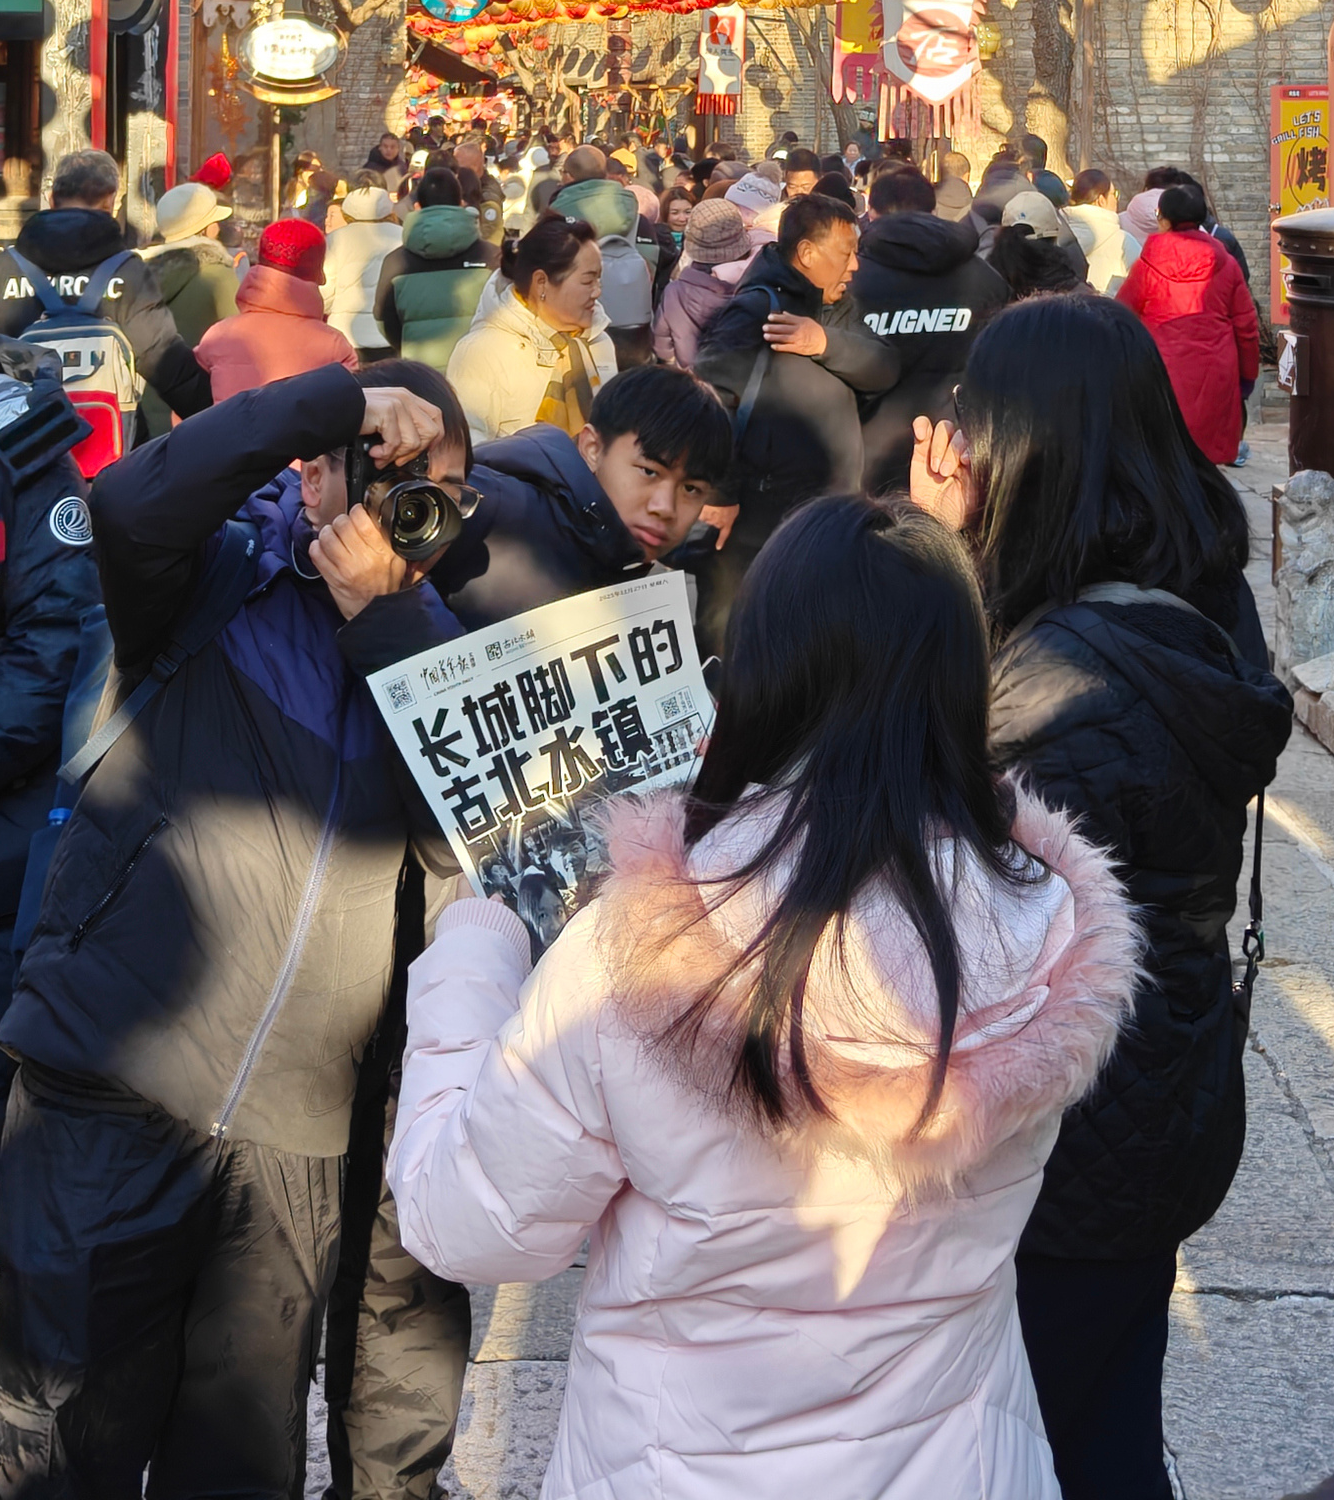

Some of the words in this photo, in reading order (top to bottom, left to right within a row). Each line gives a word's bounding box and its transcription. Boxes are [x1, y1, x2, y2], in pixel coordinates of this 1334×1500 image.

[1293, 110, 1321, 126] LET'S
[1271, 129, 1297, 145] GRILL
[1298, 126, 1320, 138] FISH
[3, 275, 125, 300] ANRCC
[412, 619, 683, 778] 长城脚下的
[442, 695, 656, 844] 古北水镇
